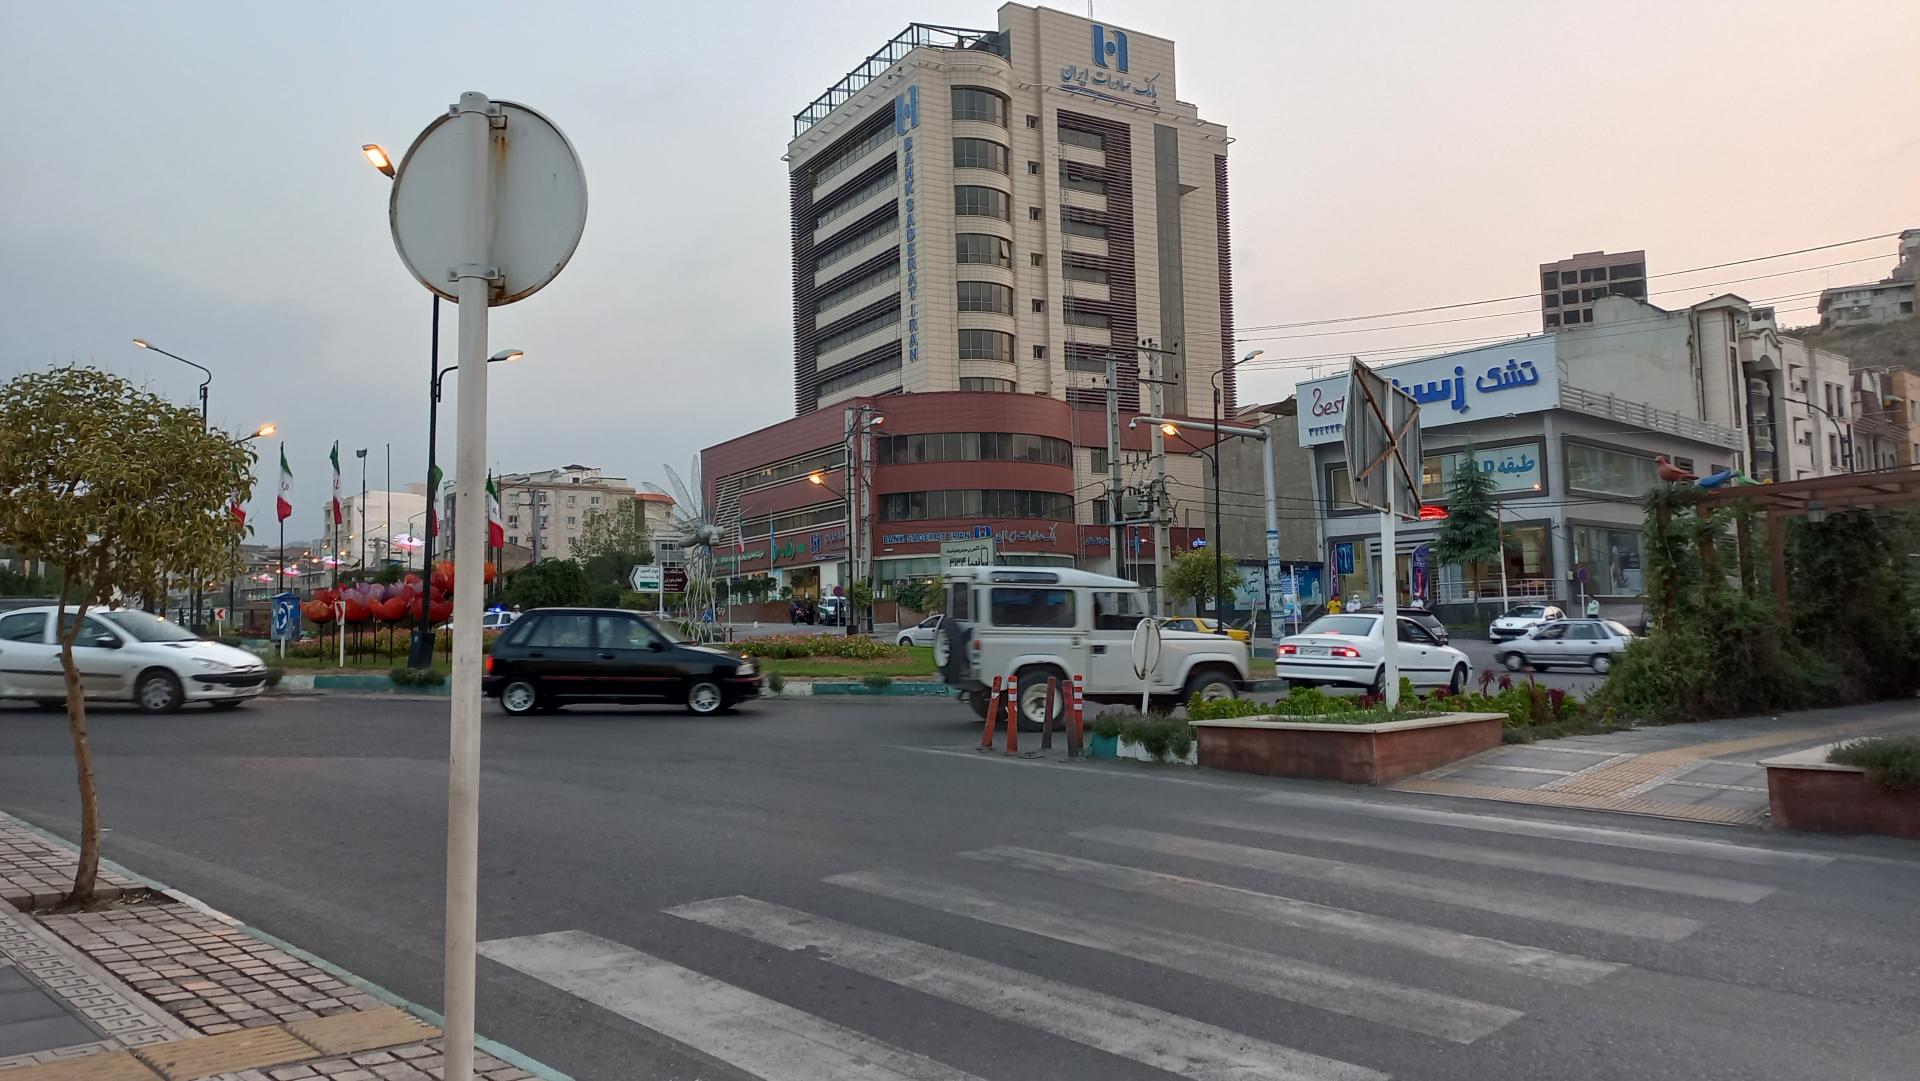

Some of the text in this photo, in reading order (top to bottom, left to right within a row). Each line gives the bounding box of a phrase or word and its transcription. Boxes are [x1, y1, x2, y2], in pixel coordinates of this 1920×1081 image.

[904, 136, 918, 363] BANK SADERAT IRAN
[1475, 358, 1539, 394] تشک
[1497, 453, 1536, 478] طبقه
[883, 534, 905, 545] BANK
[907, 532, 946, 544] SADERAT
